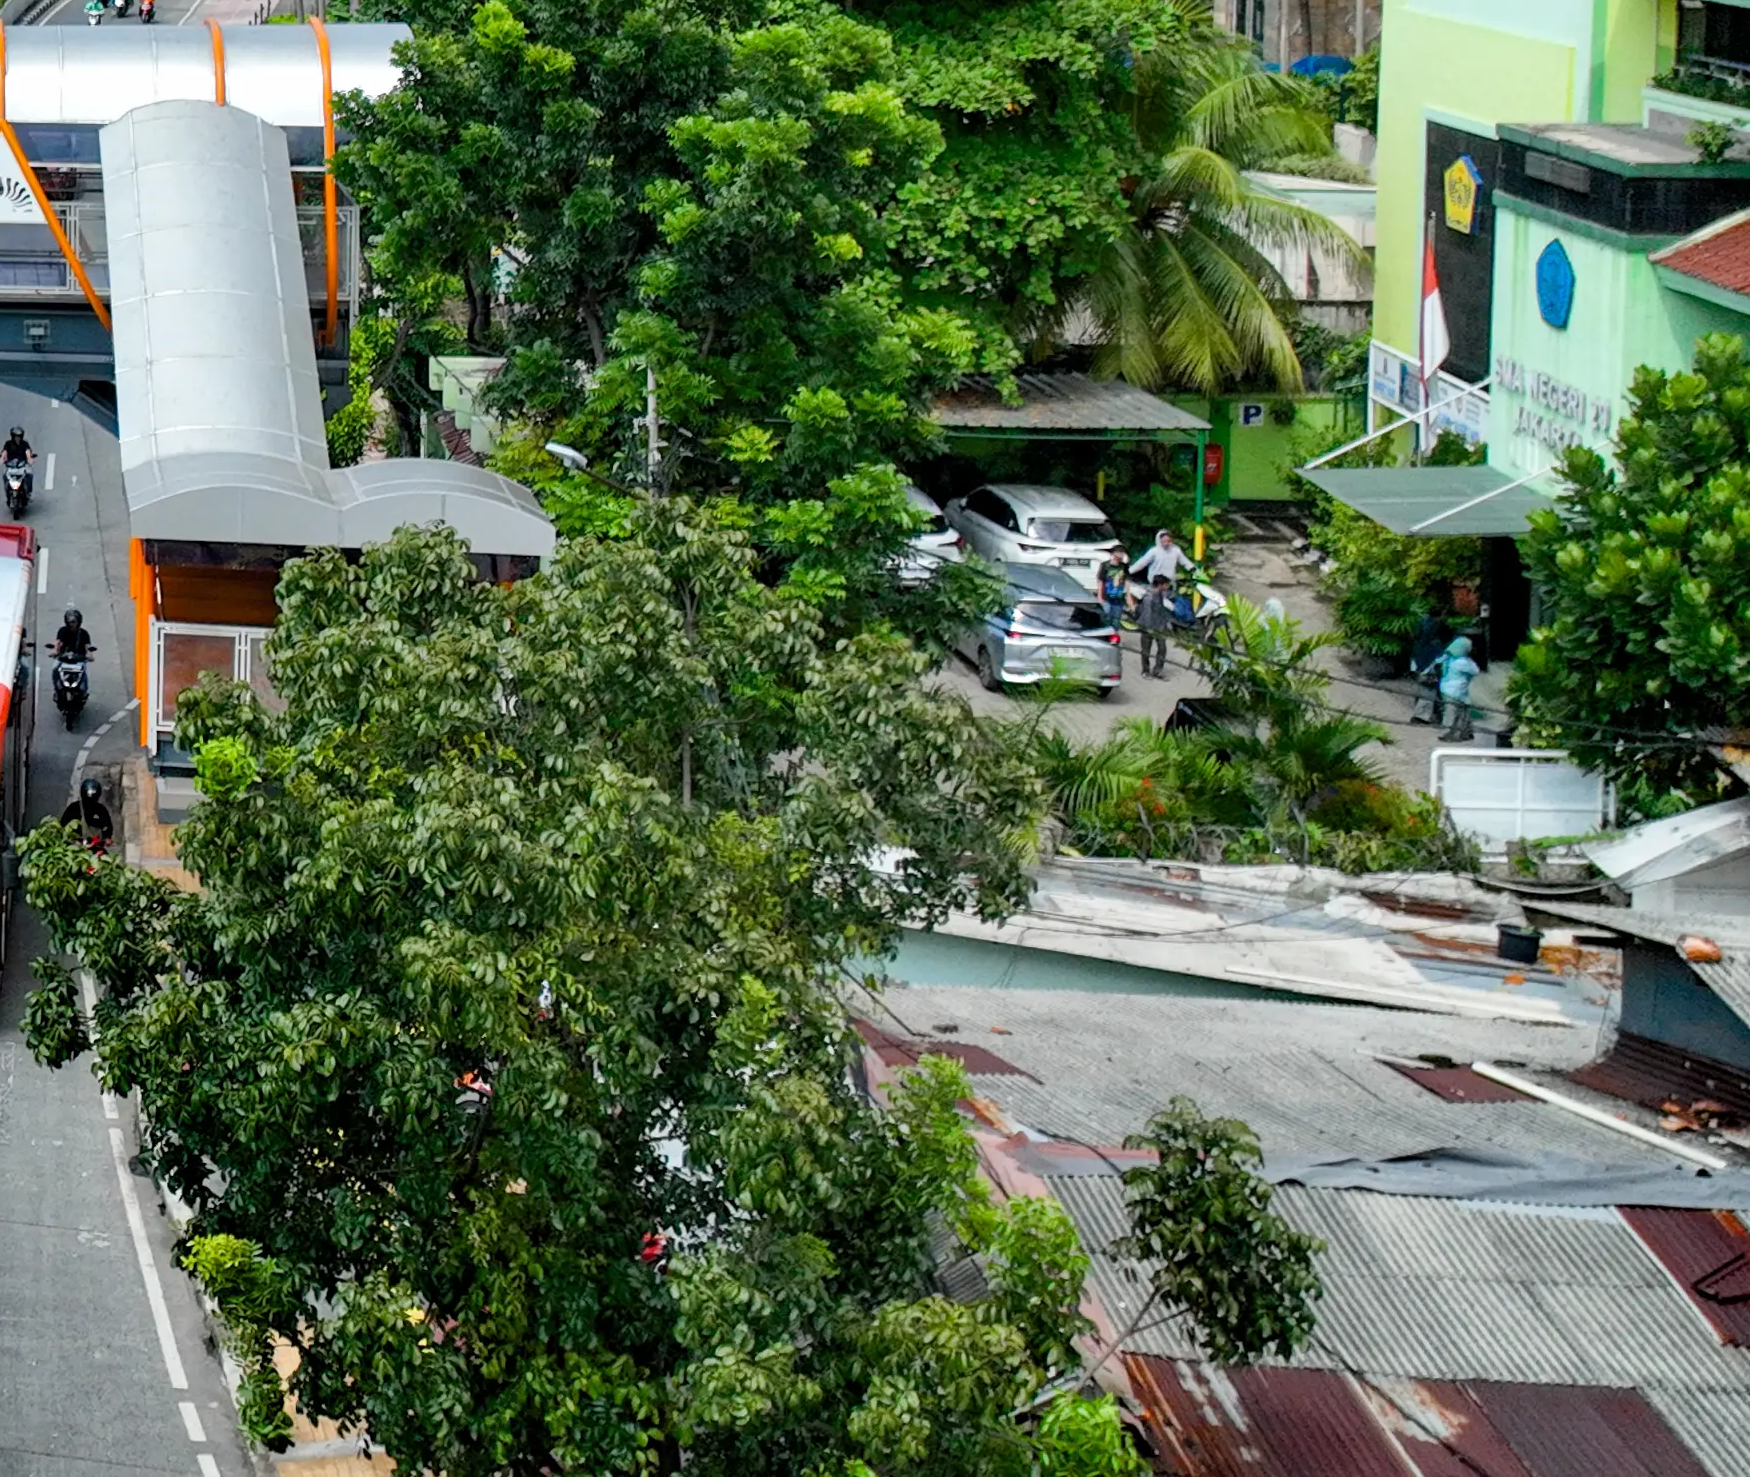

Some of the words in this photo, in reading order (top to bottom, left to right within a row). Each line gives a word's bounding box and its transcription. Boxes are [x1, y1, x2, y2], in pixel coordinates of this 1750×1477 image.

[1495, 355, 1525, 397] SMA
[1529, 371, 1586, 426] NEGERI
[1243, 405, 1262, 425] P
[1513, 406, 1583, 449] JAKARTA
